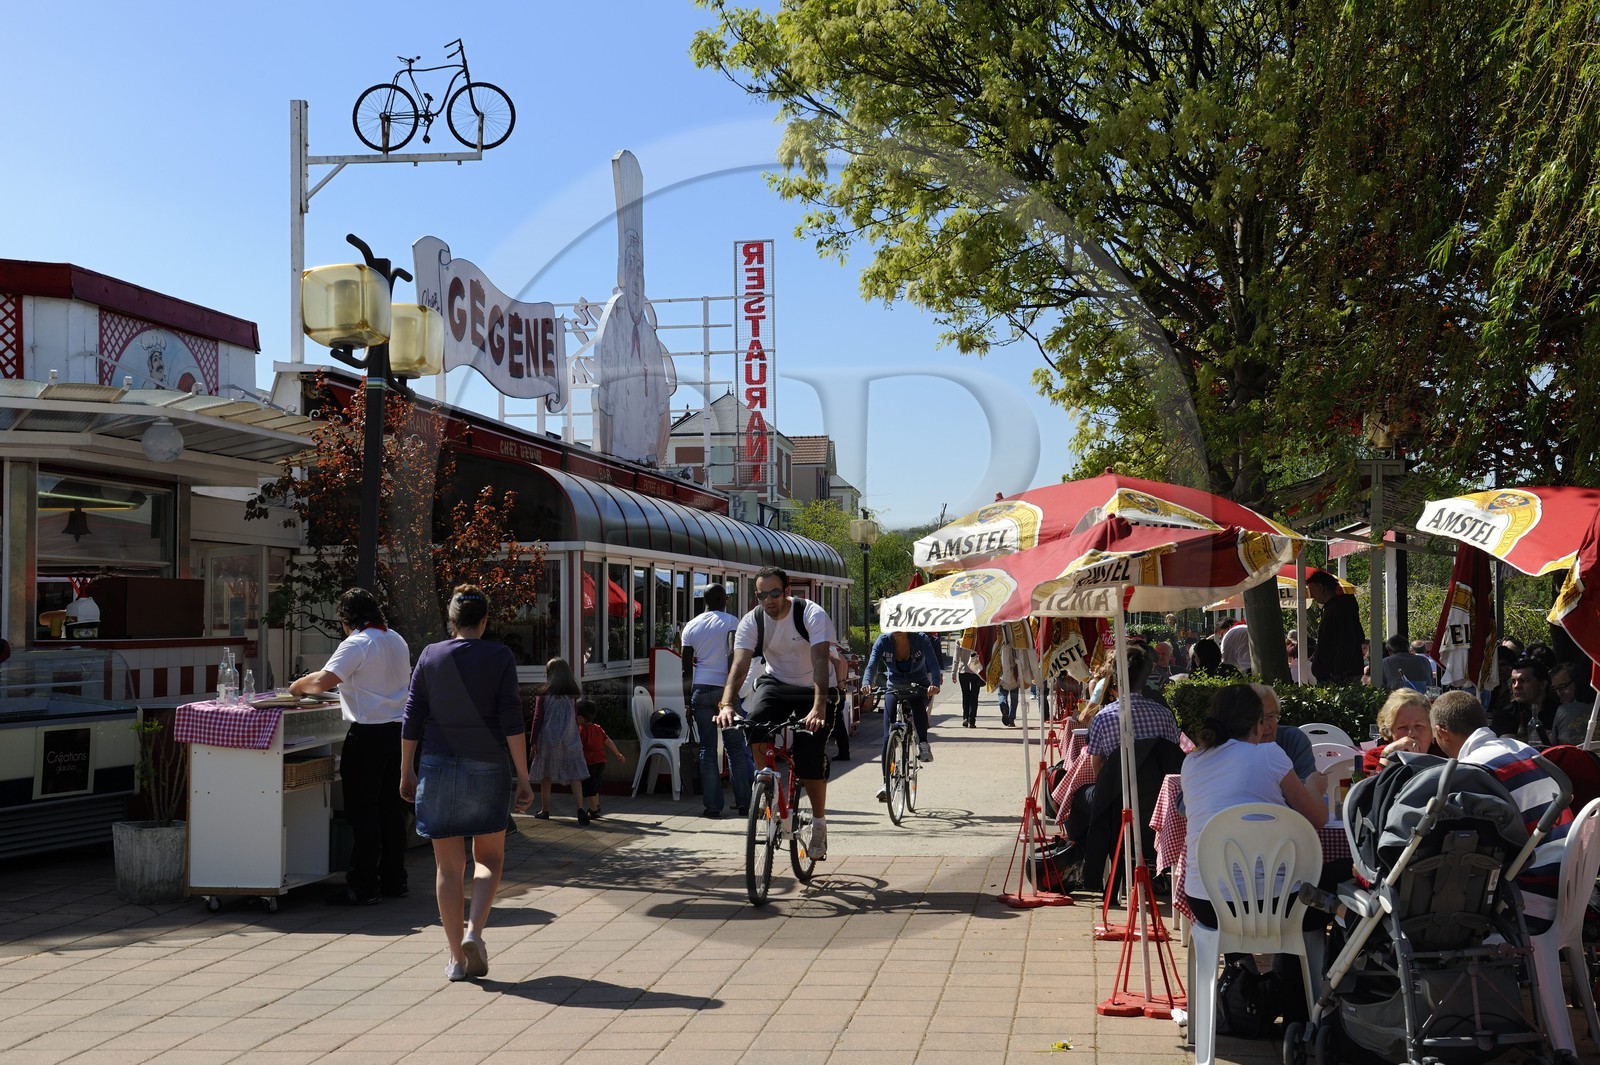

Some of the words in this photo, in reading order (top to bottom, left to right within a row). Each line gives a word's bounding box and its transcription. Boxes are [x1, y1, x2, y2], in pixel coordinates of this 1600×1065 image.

[598, 467, 613, 482] BAR
[1425, 507, 1496, 545] AMSTEL
[926, 529, 1011, 562] AMSTEL
[886, 603, 973, 627] AMSTEL
[46, 750, 87, 764] Créations
